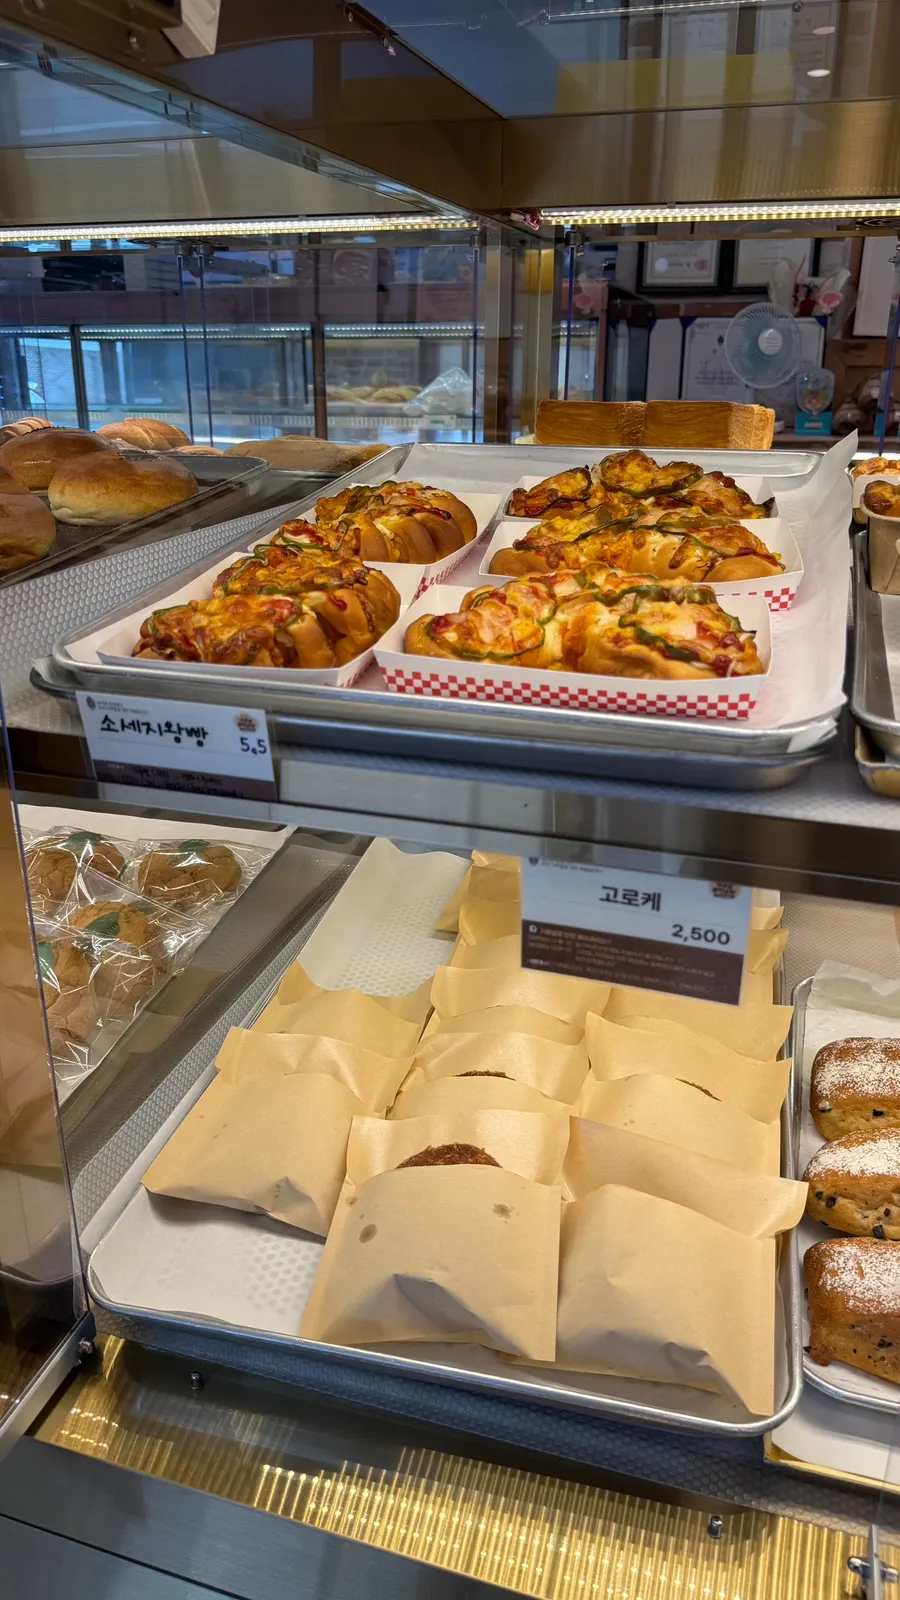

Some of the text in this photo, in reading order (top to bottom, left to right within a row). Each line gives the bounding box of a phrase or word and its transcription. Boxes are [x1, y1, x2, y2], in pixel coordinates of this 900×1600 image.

[100, 714, 209, 747] 소세지왕빵
[599, 885, 662, 912] 고로케
[671, 923, 731, 946] 2,500
